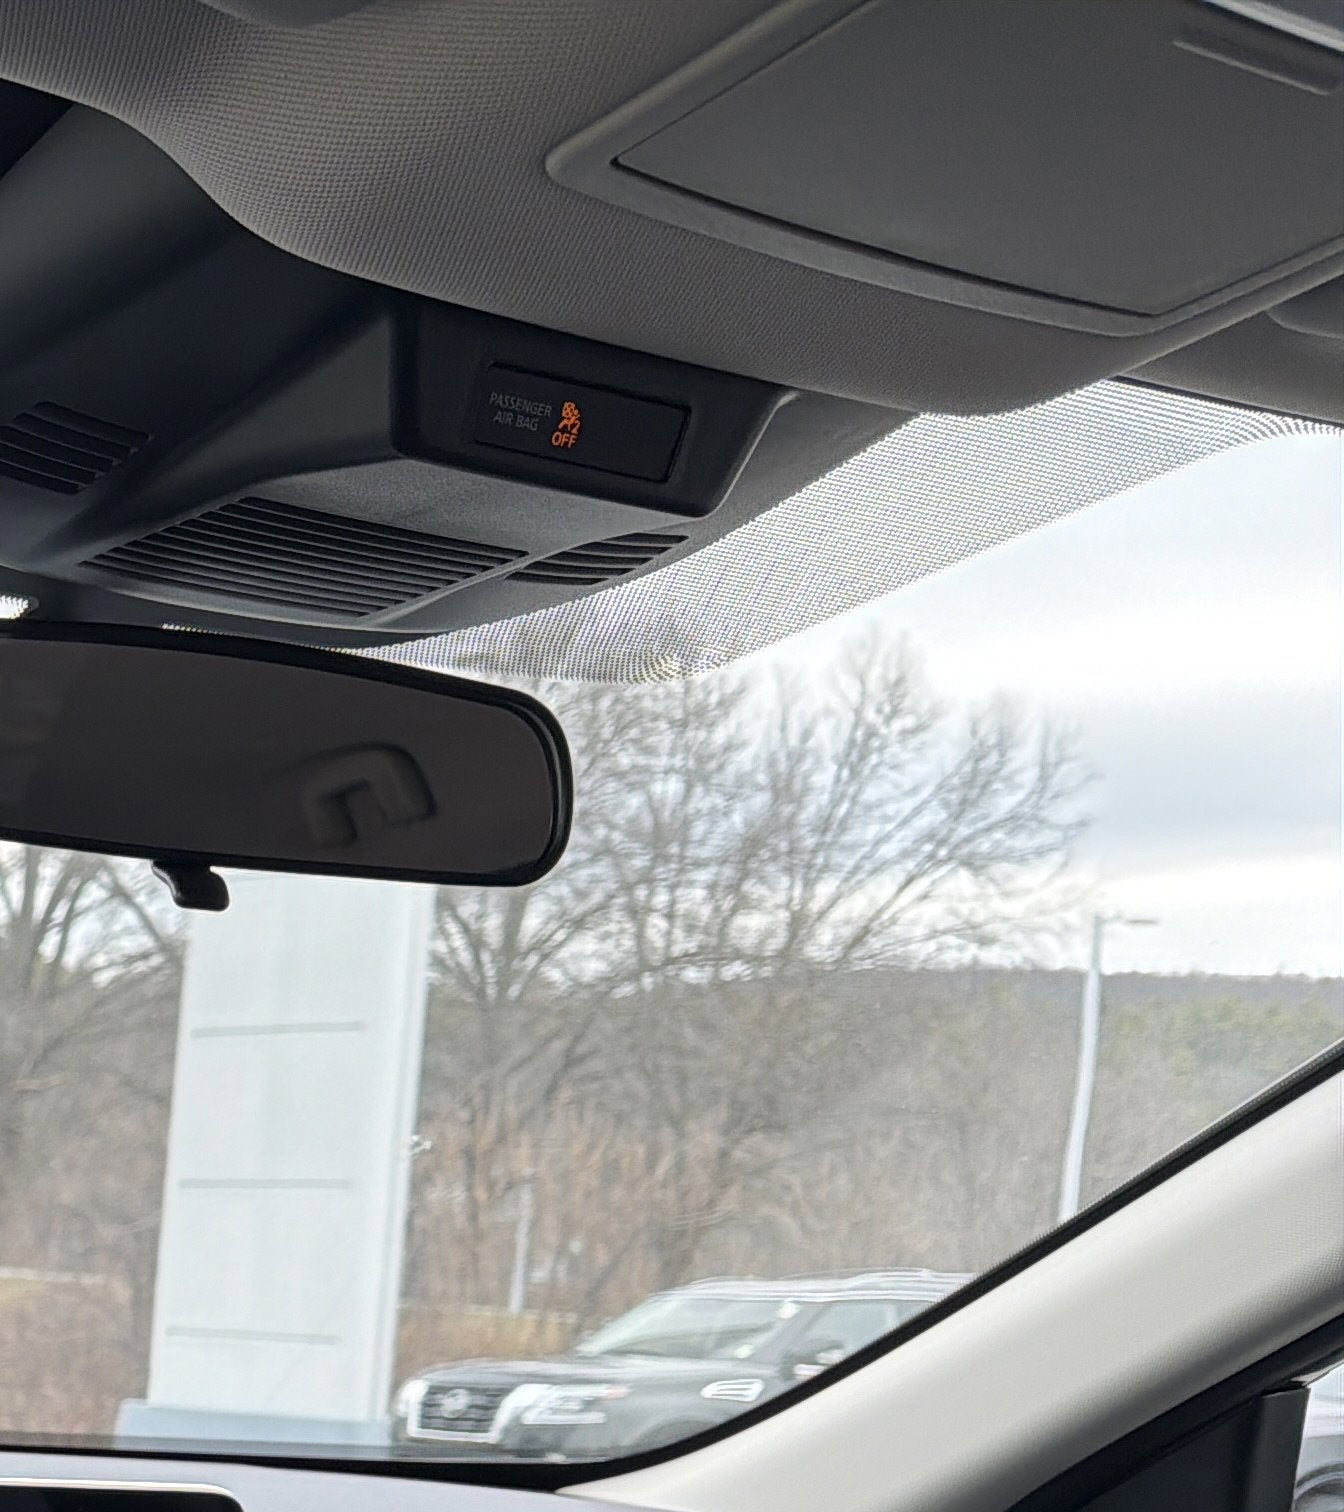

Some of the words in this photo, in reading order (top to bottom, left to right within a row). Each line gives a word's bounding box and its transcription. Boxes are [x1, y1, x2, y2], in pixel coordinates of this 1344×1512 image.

[490, 392, 552, 416] PASSENGER
[493, 411, 512, 426] AIR
[516, 415, 538, 431] BAG
[552, 431, 578, 448] OFF
